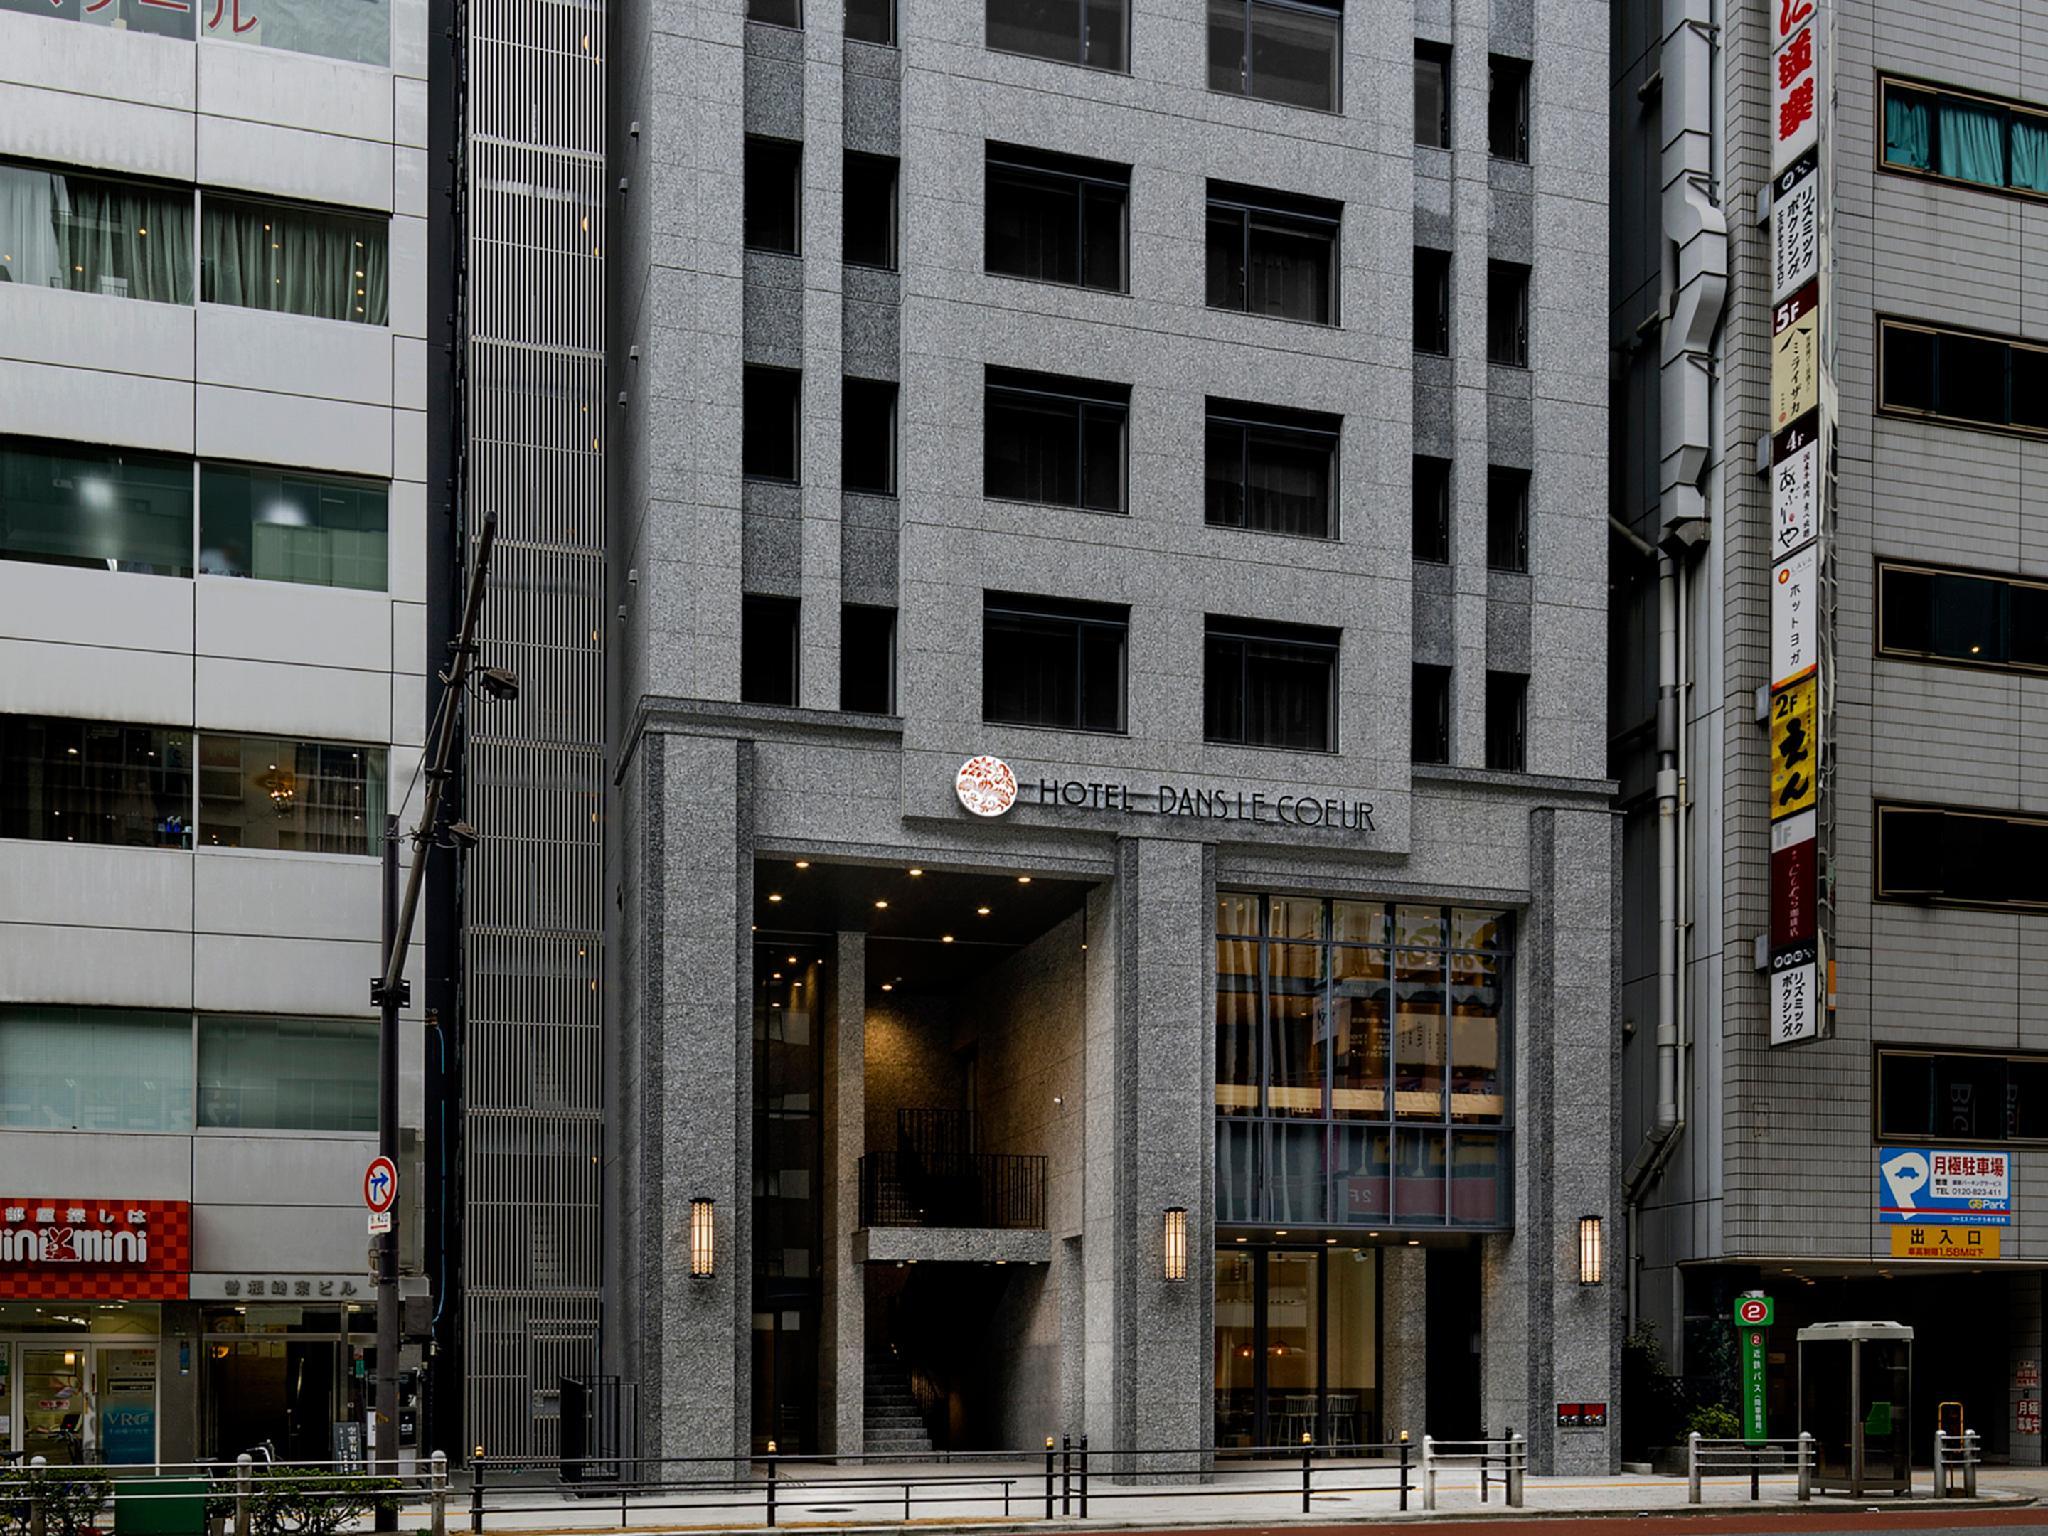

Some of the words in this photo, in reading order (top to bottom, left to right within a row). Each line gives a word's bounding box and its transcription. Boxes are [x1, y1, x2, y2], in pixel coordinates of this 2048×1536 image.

[1787, 192, 1801, 280] ボクシング
[1802, 185, 1815, 269] リズミック
[1775, 301, 1799, 334] 5F
[1790, 583, 1801, 667] ホットヨガ
[1776, 694, 1798, 720] 2F
[1040, 779, 1133, 810] HOTEL
[1159, 785, 1228, 819] DANS
[1238, 791, 1265, 822] LE
[1277, 795, 1376, 831] COEUR
[1772, 823, 1792, 849] 1F
[1782, 973, 1794, 1038] ボクシング
[1794, 971, 1806, 1035] リズミック
[1934, 1156, 2004, 1177] 月極駐車場
[0, 1229, 50, 1262] ini
[73, 1230, 147, 1262] mini
[1911, 1229, 1981, 1245] 出入口
[1748, 1305, 1760, 1318] 2
